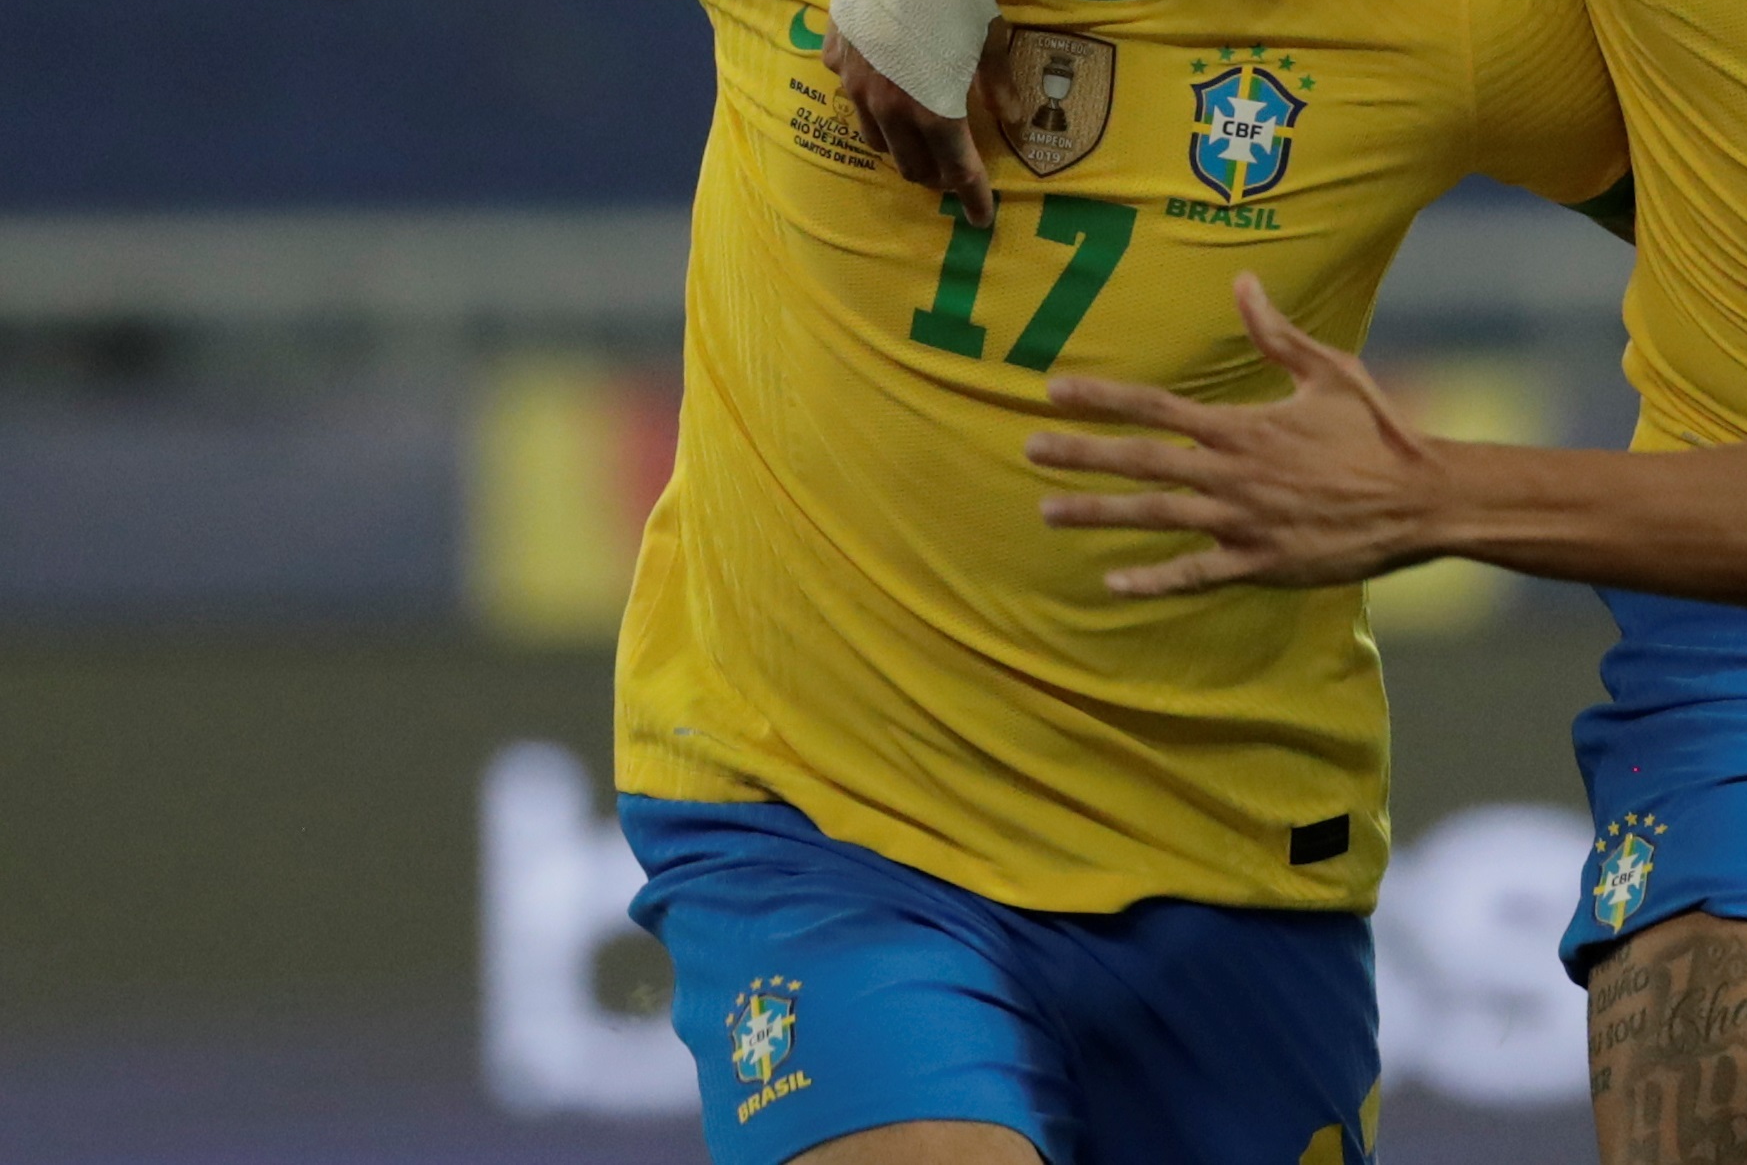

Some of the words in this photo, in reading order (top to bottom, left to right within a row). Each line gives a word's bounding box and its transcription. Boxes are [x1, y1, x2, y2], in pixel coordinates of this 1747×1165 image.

[790, 77, 827, 106] BRASIL
[790, 118, 811, 135] RIO
[812, 128, 830, 143] DE
[796, 107, 812, 122] 02
[812, 116, 849, 136] JULIO
[1222, 120, 1263, 140] CBF
[794, 135, 832, 159] CUARTOS
[834, 152, 846, 164] DE
[848, 156, 876, 171] FINAL
[1022, 131, 1074, 149] CAMPEON
[1028, 149, 1062, 164] 2019
[1165, 197, 1281, 231] BRASIL
[909, 189, 1139, 373] 17
[1611, 869, 1636, 887] CBF
[748, 1024, 773, 1047] CBF
[737, 1070, 812, 1125] BRASIL
